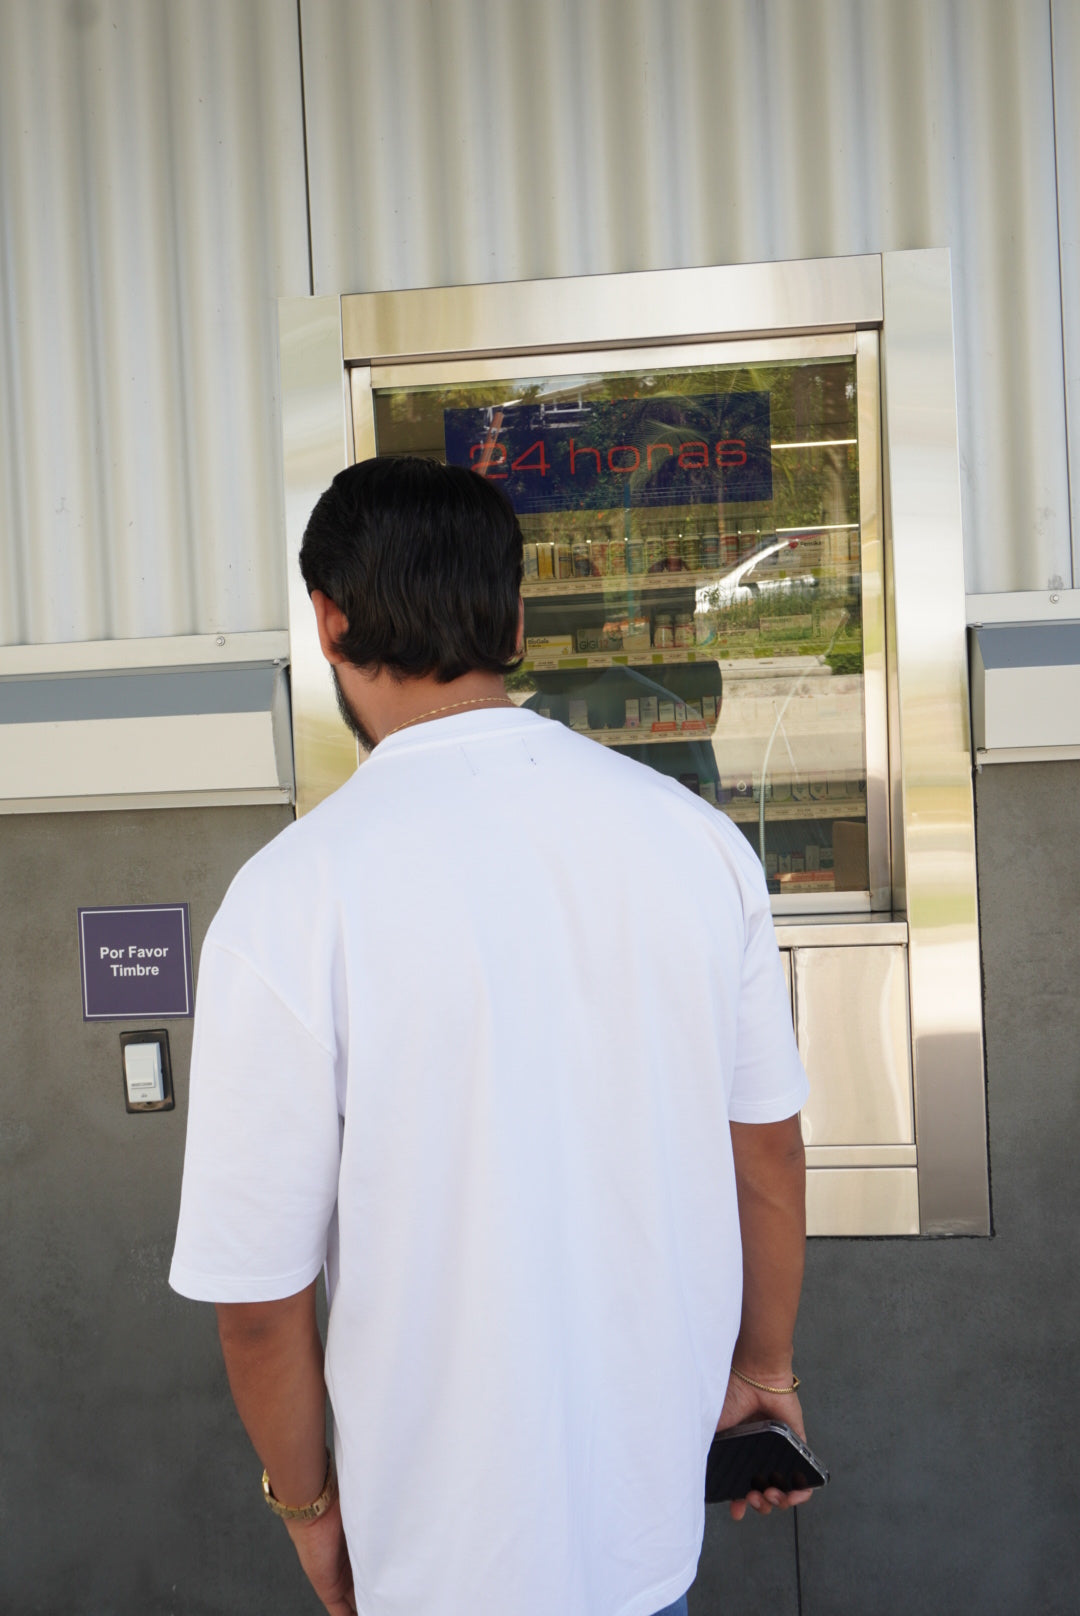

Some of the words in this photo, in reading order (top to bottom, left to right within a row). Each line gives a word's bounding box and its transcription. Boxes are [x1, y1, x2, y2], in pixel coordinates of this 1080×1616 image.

[469, 440, 550, 479] 24
[569, 438, 748, 474] horas
[99, 946, 125, 959] Por
[128, 945, 169, 958] Favor
[110, 963, 160, 977] Timbre
